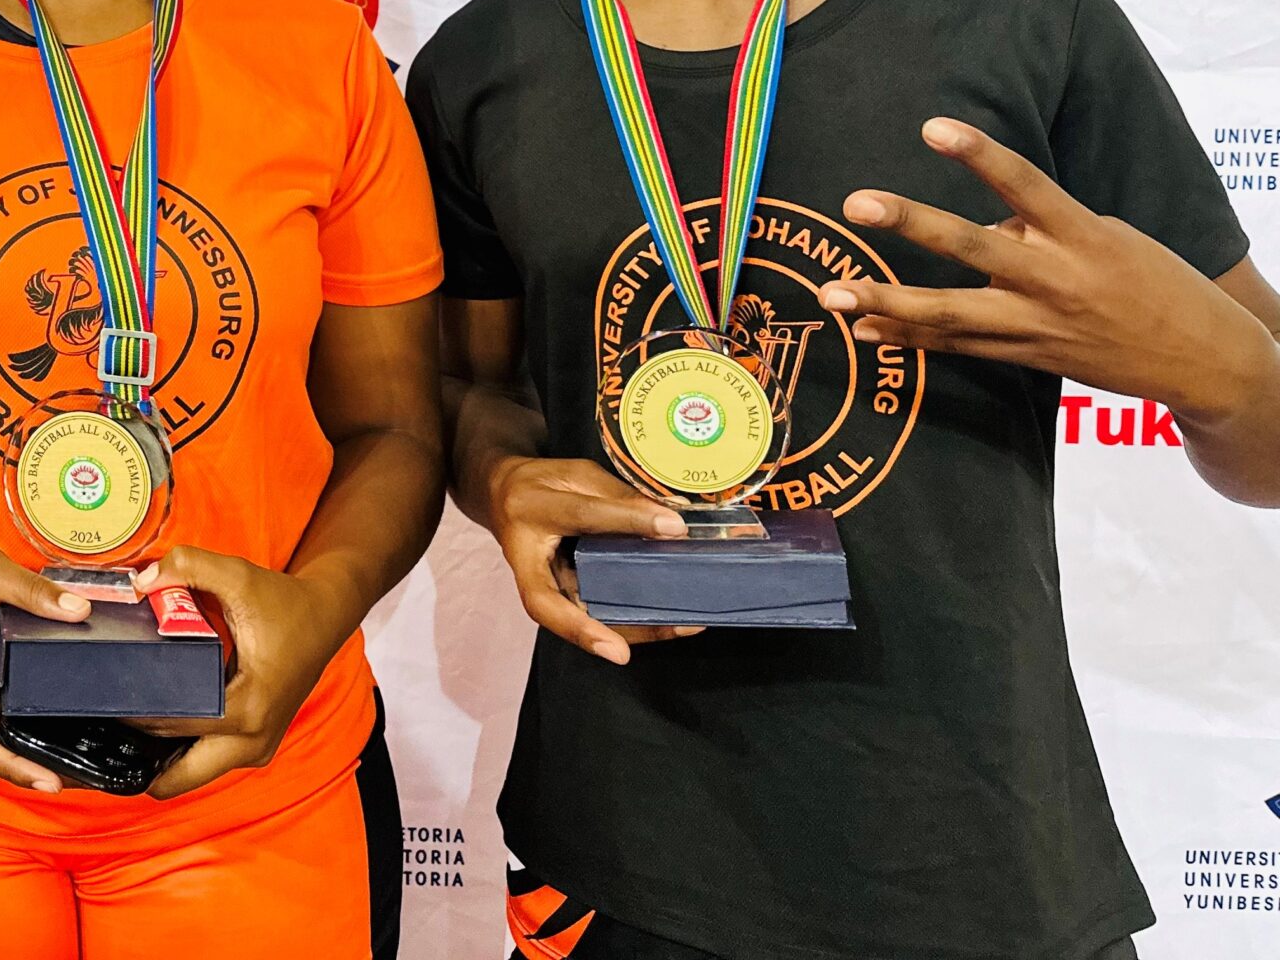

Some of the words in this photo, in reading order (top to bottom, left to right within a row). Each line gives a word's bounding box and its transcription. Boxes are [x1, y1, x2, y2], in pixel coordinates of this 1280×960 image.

[17, 178, 56, 206] OF
[1219, 174, 1277, 191] UNIB
[603, 241, 663, 421] NIVERSITY
[694, 361, 720, 377] ALL
[631, 360, 690, 416] BASKETBALL
[723, 371, 752, 402] STAR
[79, 423, 100, 437] ALL
[631, 420, 647, 442] 3x3
[746, 405, 761, 442] MALE
[28, 424, 75, 478] BASKETBALL
[103, 430, 128, 457] STAR
[125, 457, 141, 504] FEMALE
[681, 469, 720, 483] 2024
[27, 481, 41, 502] 3x3
[69, 530, 102, 544] 2024
[1185, 850, 1280, 866] UNIVERSI
